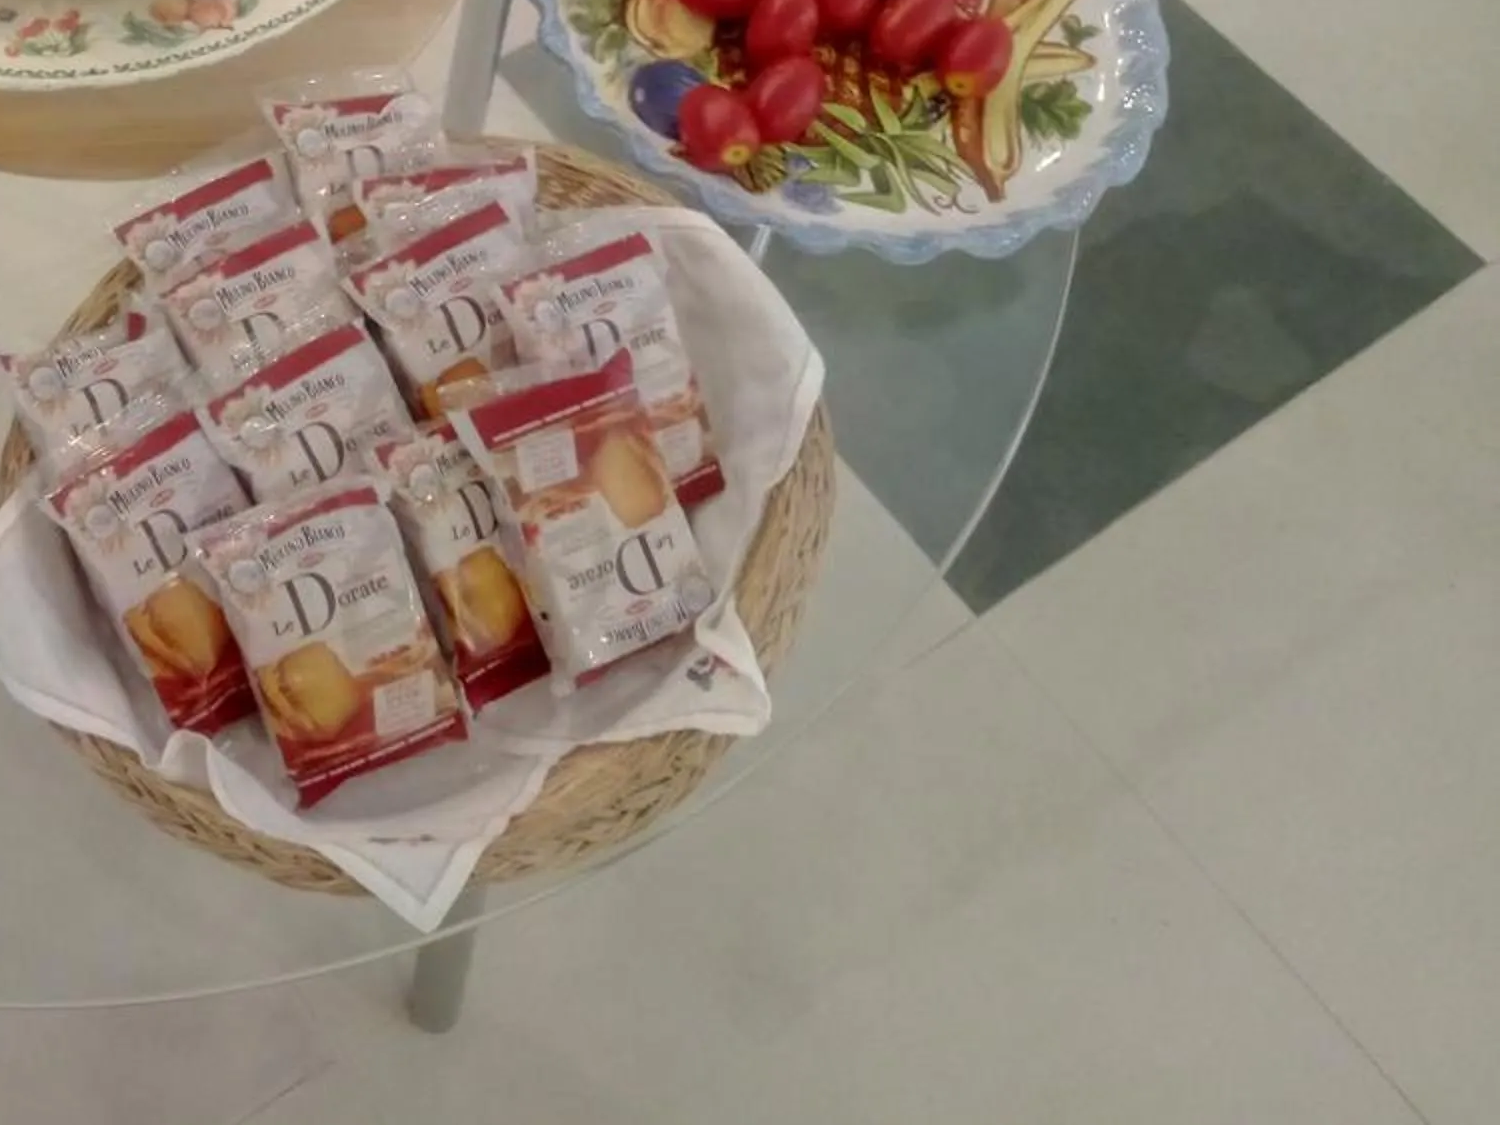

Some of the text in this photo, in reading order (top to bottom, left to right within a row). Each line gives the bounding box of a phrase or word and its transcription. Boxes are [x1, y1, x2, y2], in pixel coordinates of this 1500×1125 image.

[426, 335, 450, 355] Le
[133, 555, 154, 576] Le
[277, 572, 391, 637] Dorate
[271, 619, 294, 637] Le
